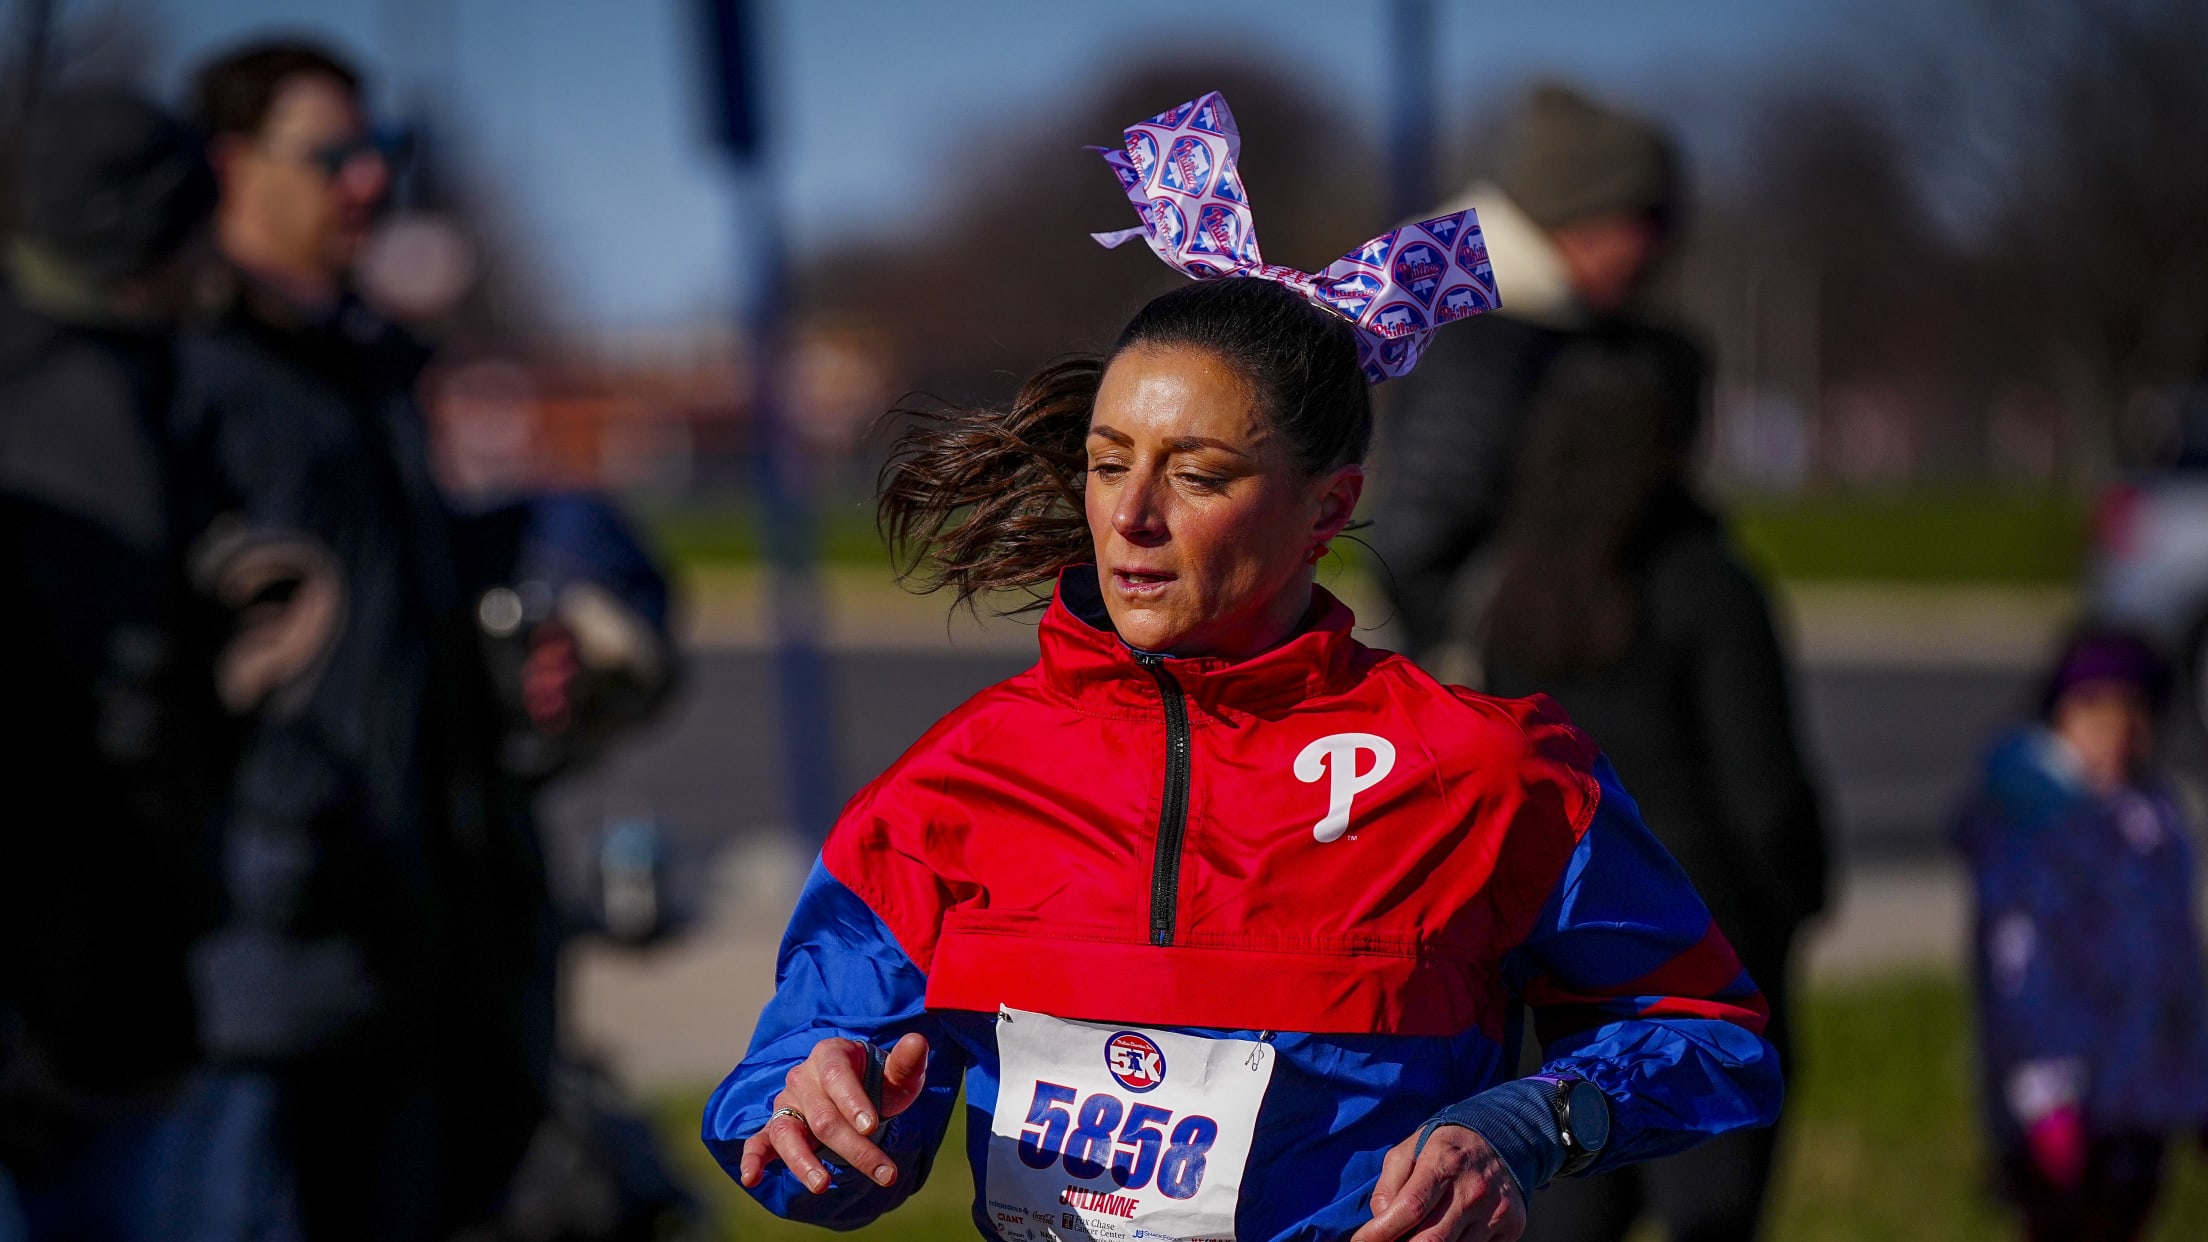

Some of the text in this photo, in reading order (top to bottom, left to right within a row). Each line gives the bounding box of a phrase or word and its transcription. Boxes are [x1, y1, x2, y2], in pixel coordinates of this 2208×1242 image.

[1174, 140, 1198, 190] Phillies
[1293, 732, 1396, 843] P
[1110, 1045, 1161, 1083] 5K
[1018, 1080, 1218, 1200] 5858
[997, 1213, 1024, 1225] GIANT
[1059, 1184, 1140, 1219] JULIANNE
[1074, 1224, 1099, 1236] Cancer
[1099, 1229, 1126, 1240] Center
[1075, 1215, 1115, 1231] Fox Chase
